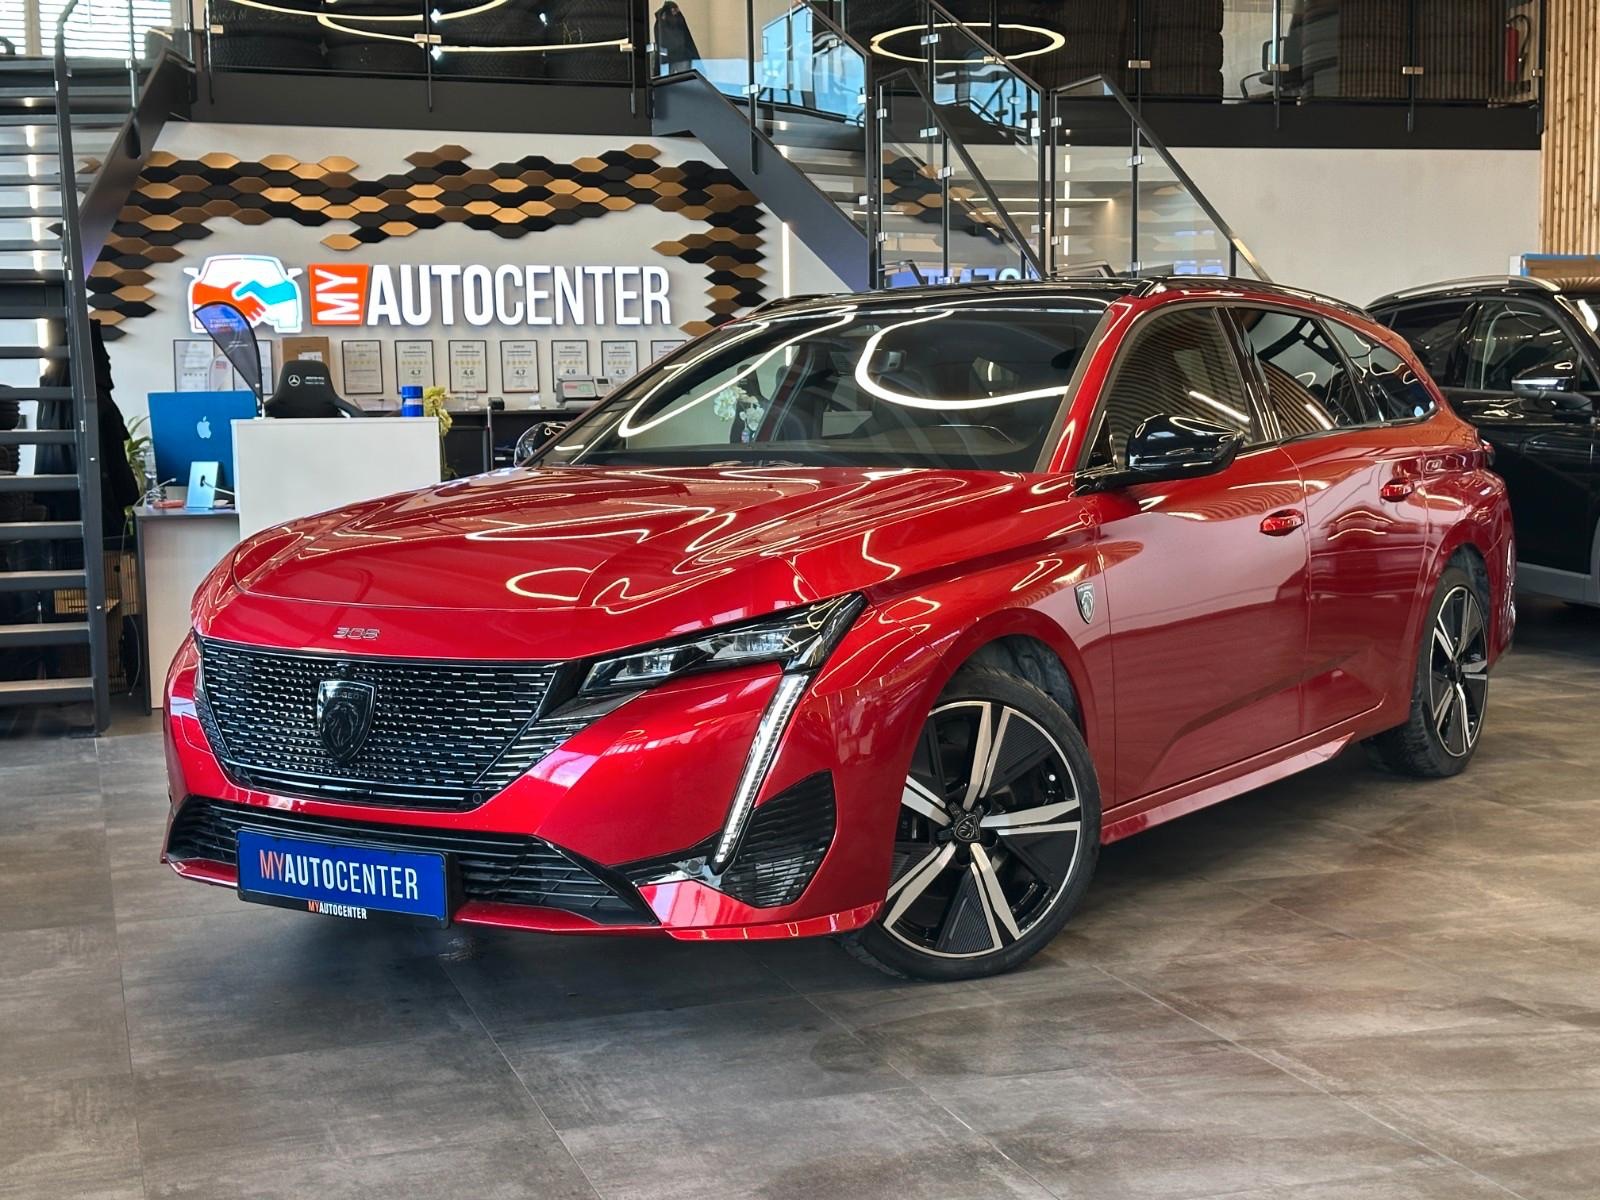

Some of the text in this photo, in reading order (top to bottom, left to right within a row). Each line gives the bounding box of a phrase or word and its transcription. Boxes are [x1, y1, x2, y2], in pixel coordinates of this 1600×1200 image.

[315, 264, 672, 326] MY AUTOCENTER
[327, 690, 365, 700] EUGEOT
[259, 849, 419, 900] MYAUTOCENTER
[307, 900, 368, 920] MYAUTOCENTER
